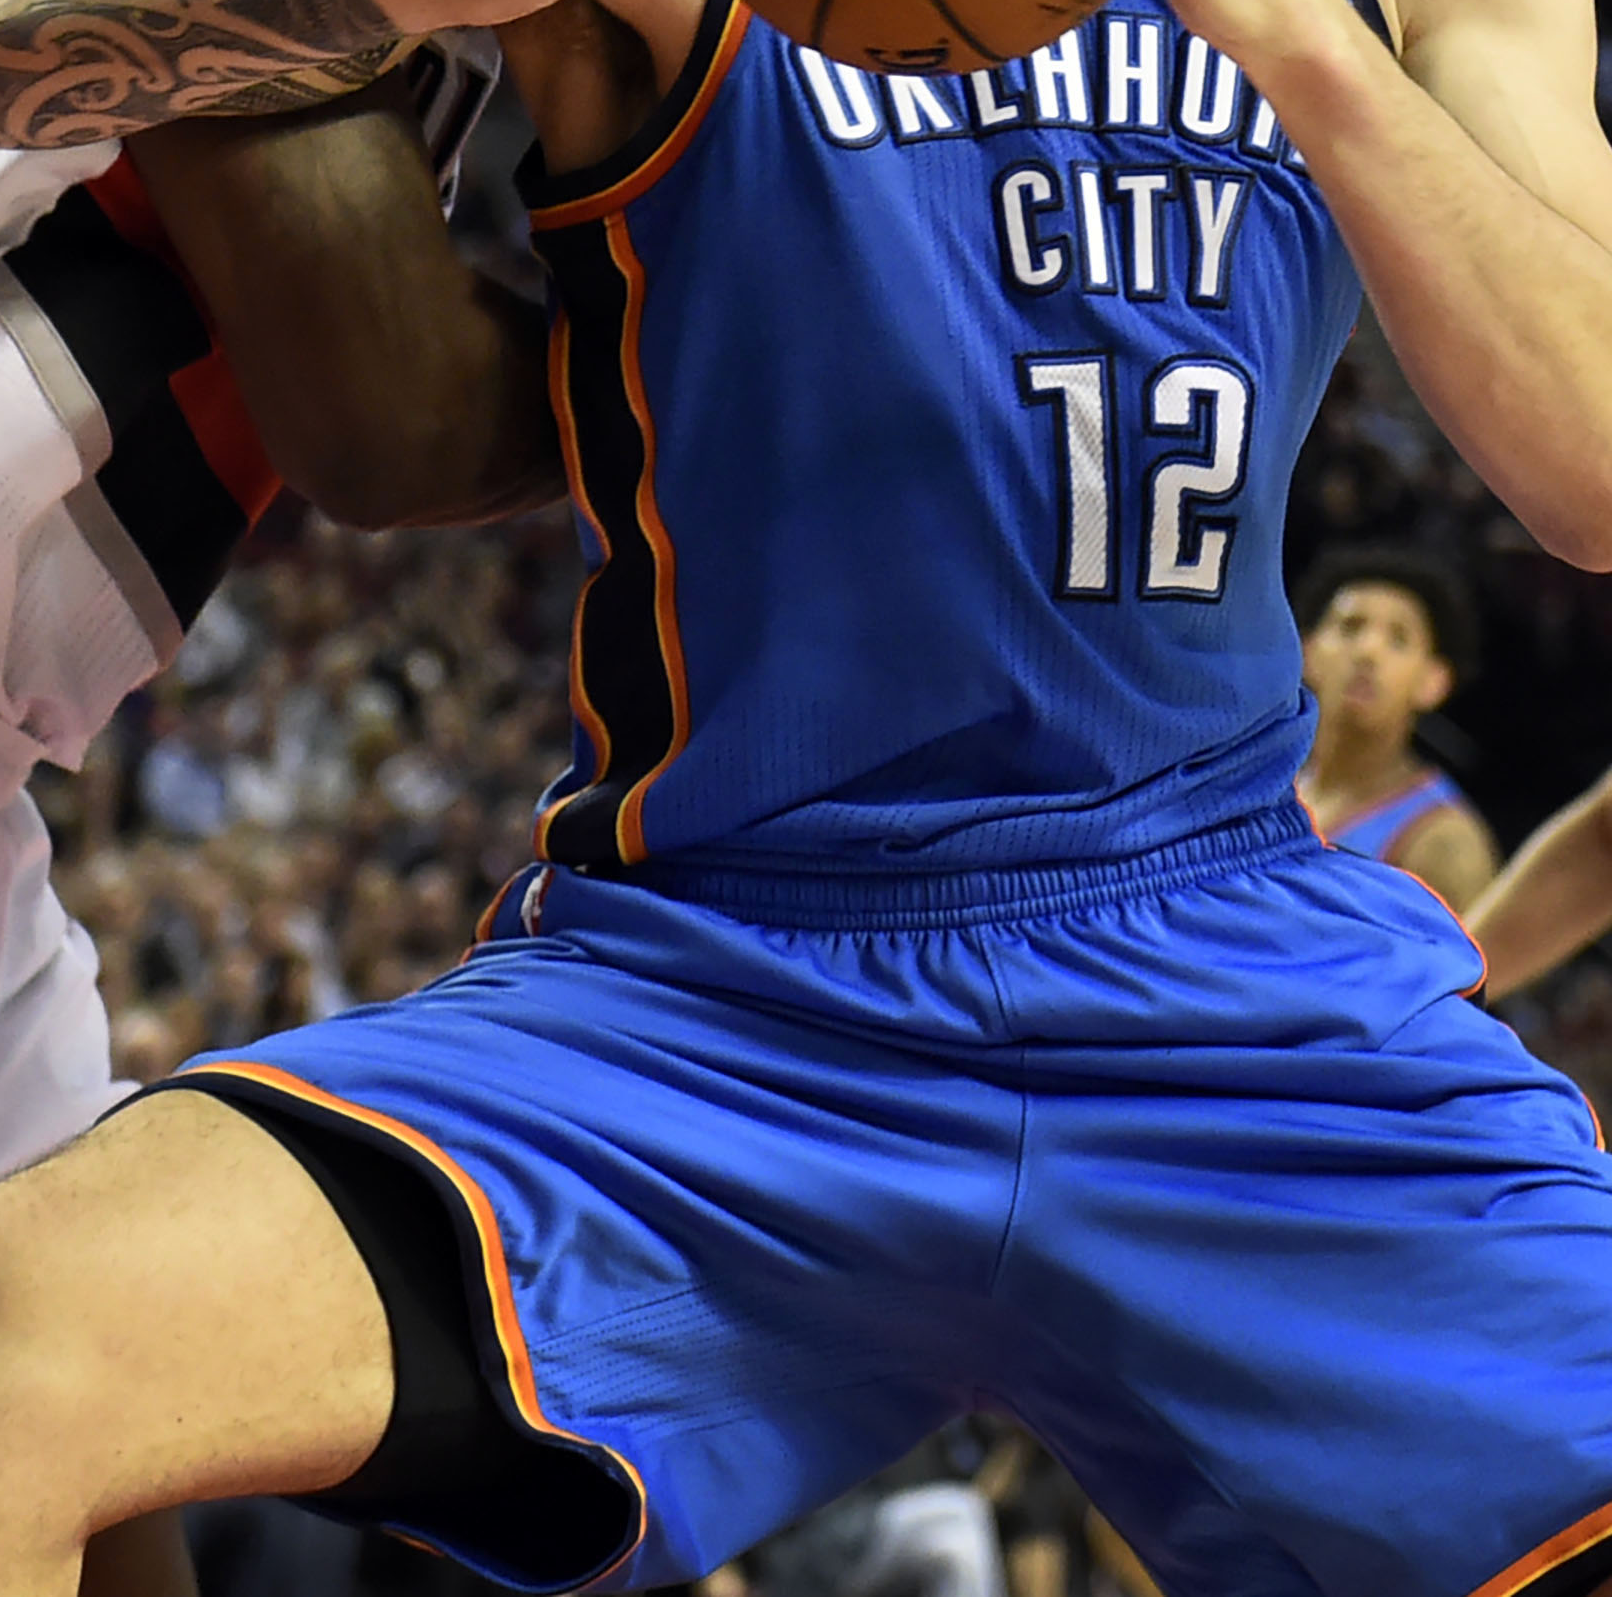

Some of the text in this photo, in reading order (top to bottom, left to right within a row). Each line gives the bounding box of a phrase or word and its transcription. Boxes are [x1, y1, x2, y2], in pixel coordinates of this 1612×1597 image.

[789, 11, 1308, 173] OKLAHO
[993, 160, 1255, 308] CITY
[1016, 349, 1254, 602] 12
